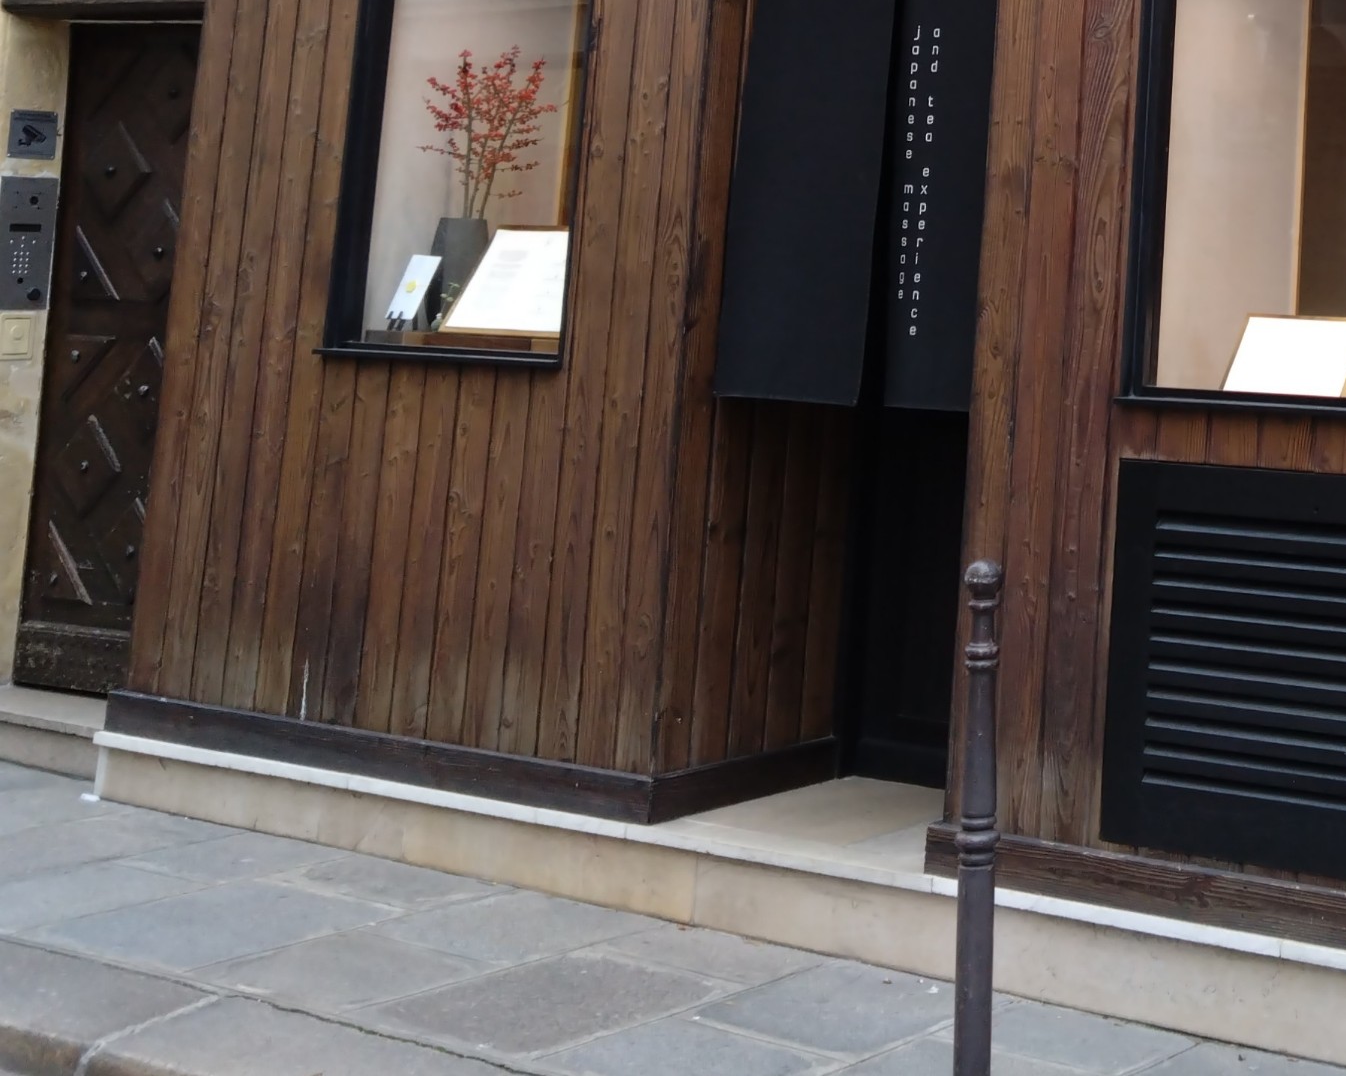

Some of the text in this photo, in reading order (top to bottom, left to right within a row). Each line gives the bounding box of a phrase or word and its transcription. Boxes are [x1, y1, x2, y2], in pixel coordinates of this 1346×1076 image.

[897, 184, 914, 300] massage
[909, 28, 941, 336] and tea experience
